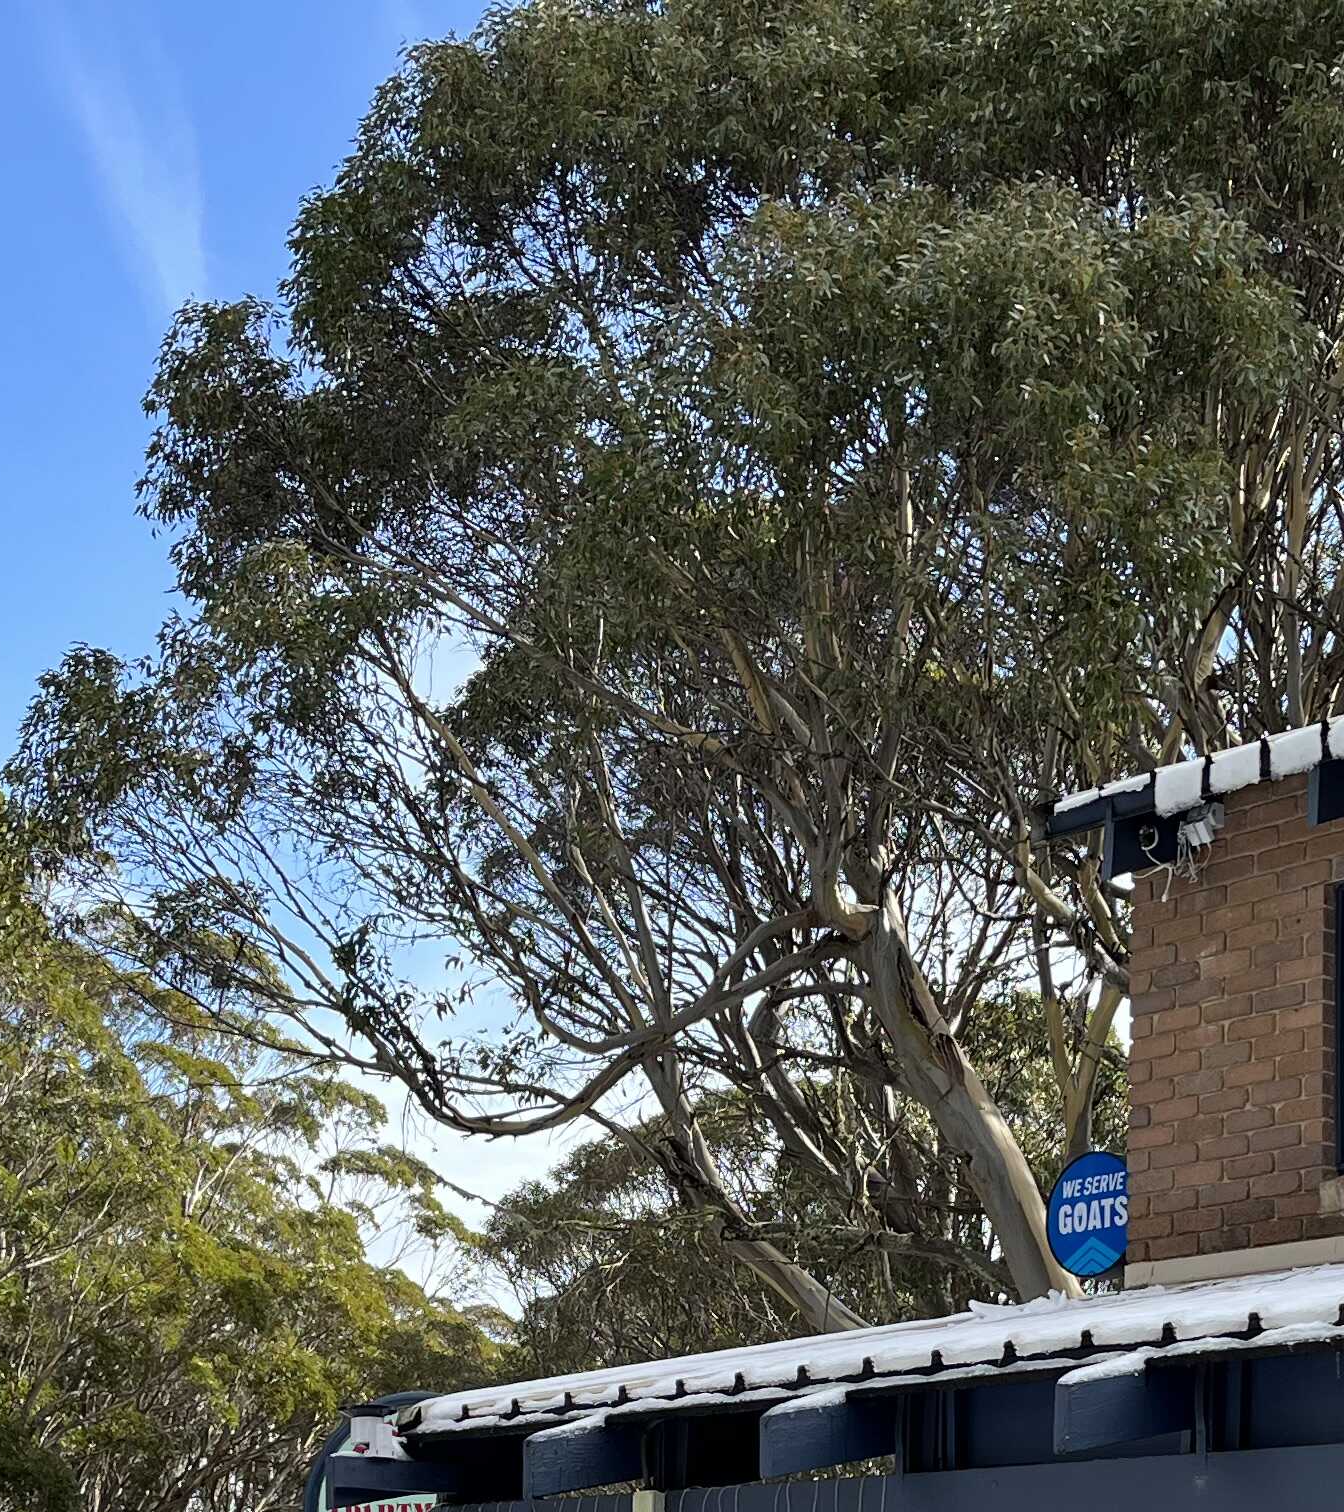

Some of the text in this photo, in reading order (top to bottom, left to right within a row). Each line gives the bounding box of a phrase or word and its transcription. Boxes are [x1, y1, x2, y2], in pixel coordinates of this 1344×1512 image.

[1062, 1171, 1126, 1199] WE SERVE
[1058, 1195, 1128, 1235] GOATS
